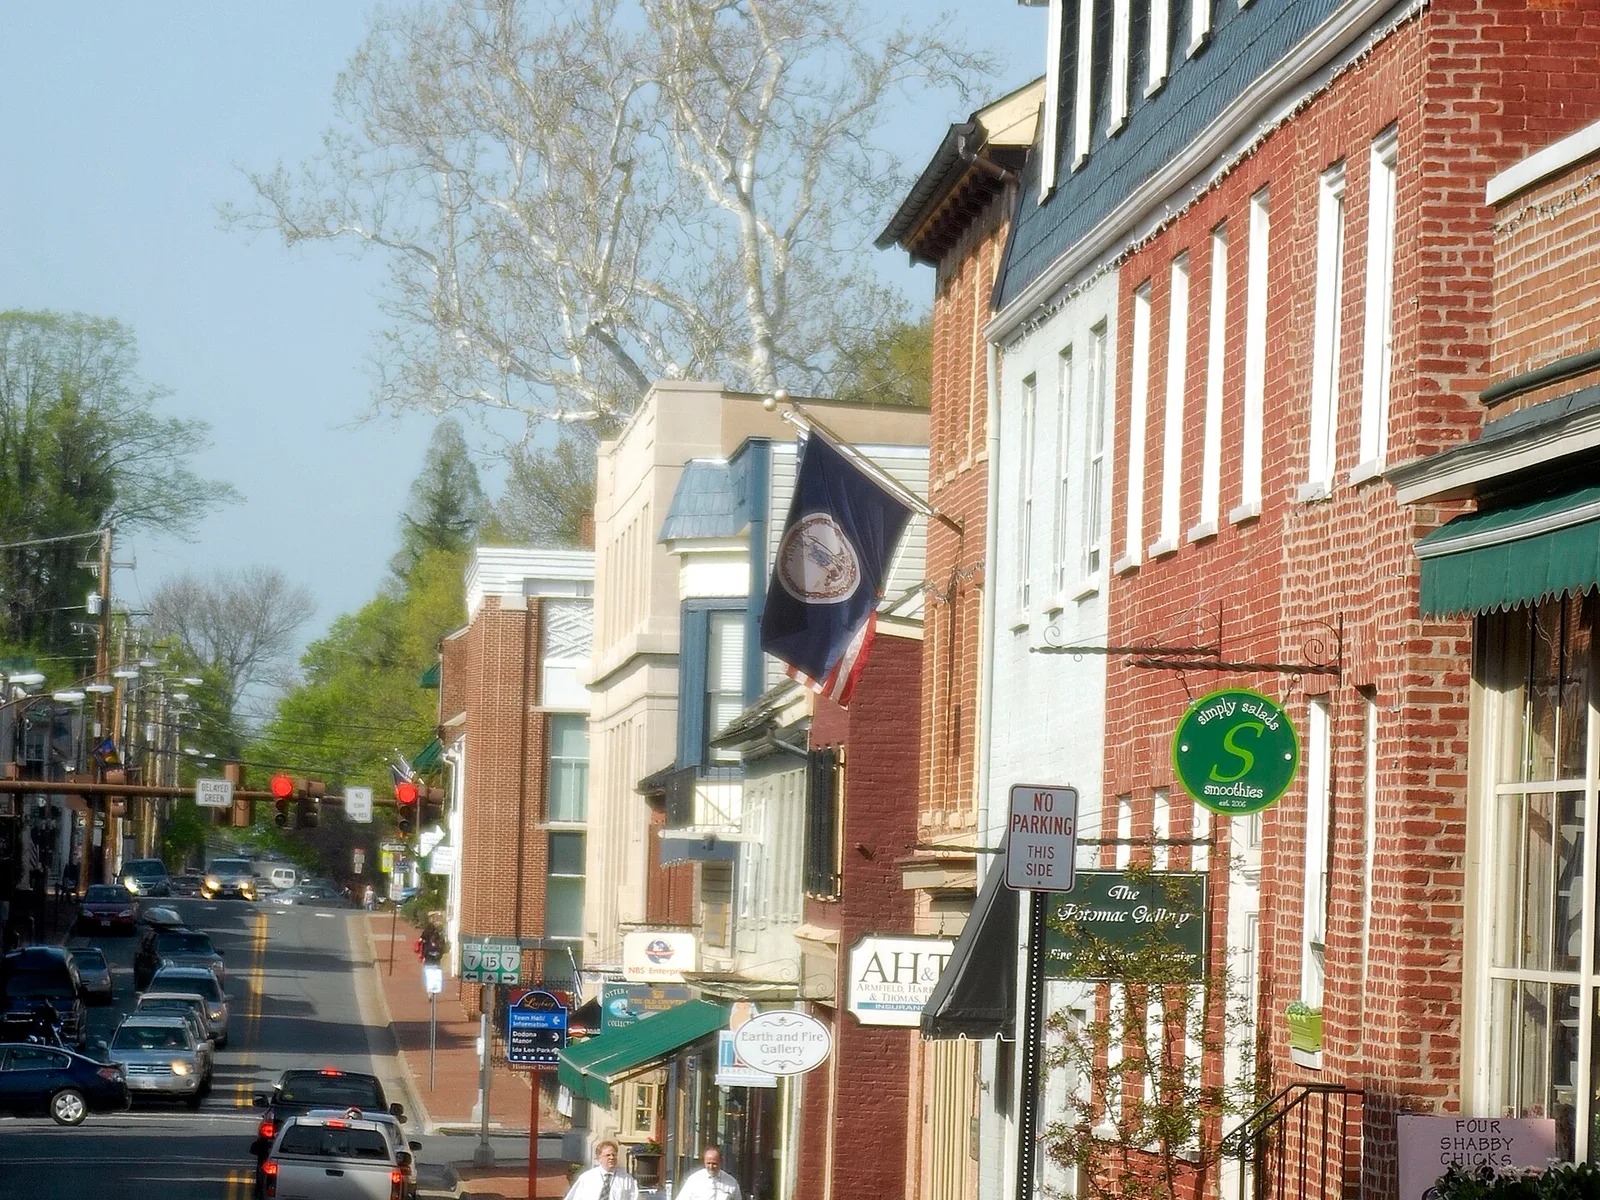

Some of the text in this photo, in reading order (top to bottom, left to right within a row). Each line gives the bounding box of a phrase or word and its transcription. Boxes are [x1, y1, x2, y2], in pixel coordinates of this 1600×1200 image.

[1197, 697, 1280, 731] simply salads
[1208, 721, 1265, 783] S
[201, 783, 229, 793] DELAYED
[1203, 782, 1264, 799] smoothies
[204, 793, 225, 802] GREEN
[354, 792, 364, 800] NO
[1033, 793, 1054, 812] NO
[1012, 814, 1073, 836] PARKING
[1027, 845, 1055, 860] THIS
[1025, 863, 1054, 877] SIDE
[1107, 885, 1141, 900] The
[1057, 903, 1129, 921] Potomac
[468, 955, 514, 968] 7 15 7
[628, 967, 645, 975] NBS
[604, 988, 625, 999] OTTER
[869, 993, 877, 1001] &
[741, 1031, 773, 1042] Earth
[776, 1031, 798, 1042] and
[801, 1032, 824, 1042] Fire
[760, 1044, 805, 1057] Gallery
[1455, 1119, 1502, 1134] FOUR
[1440, 1137, 1514, 1151] SHABBY
[1440, 1152, 1513, 1166] CHICKS
